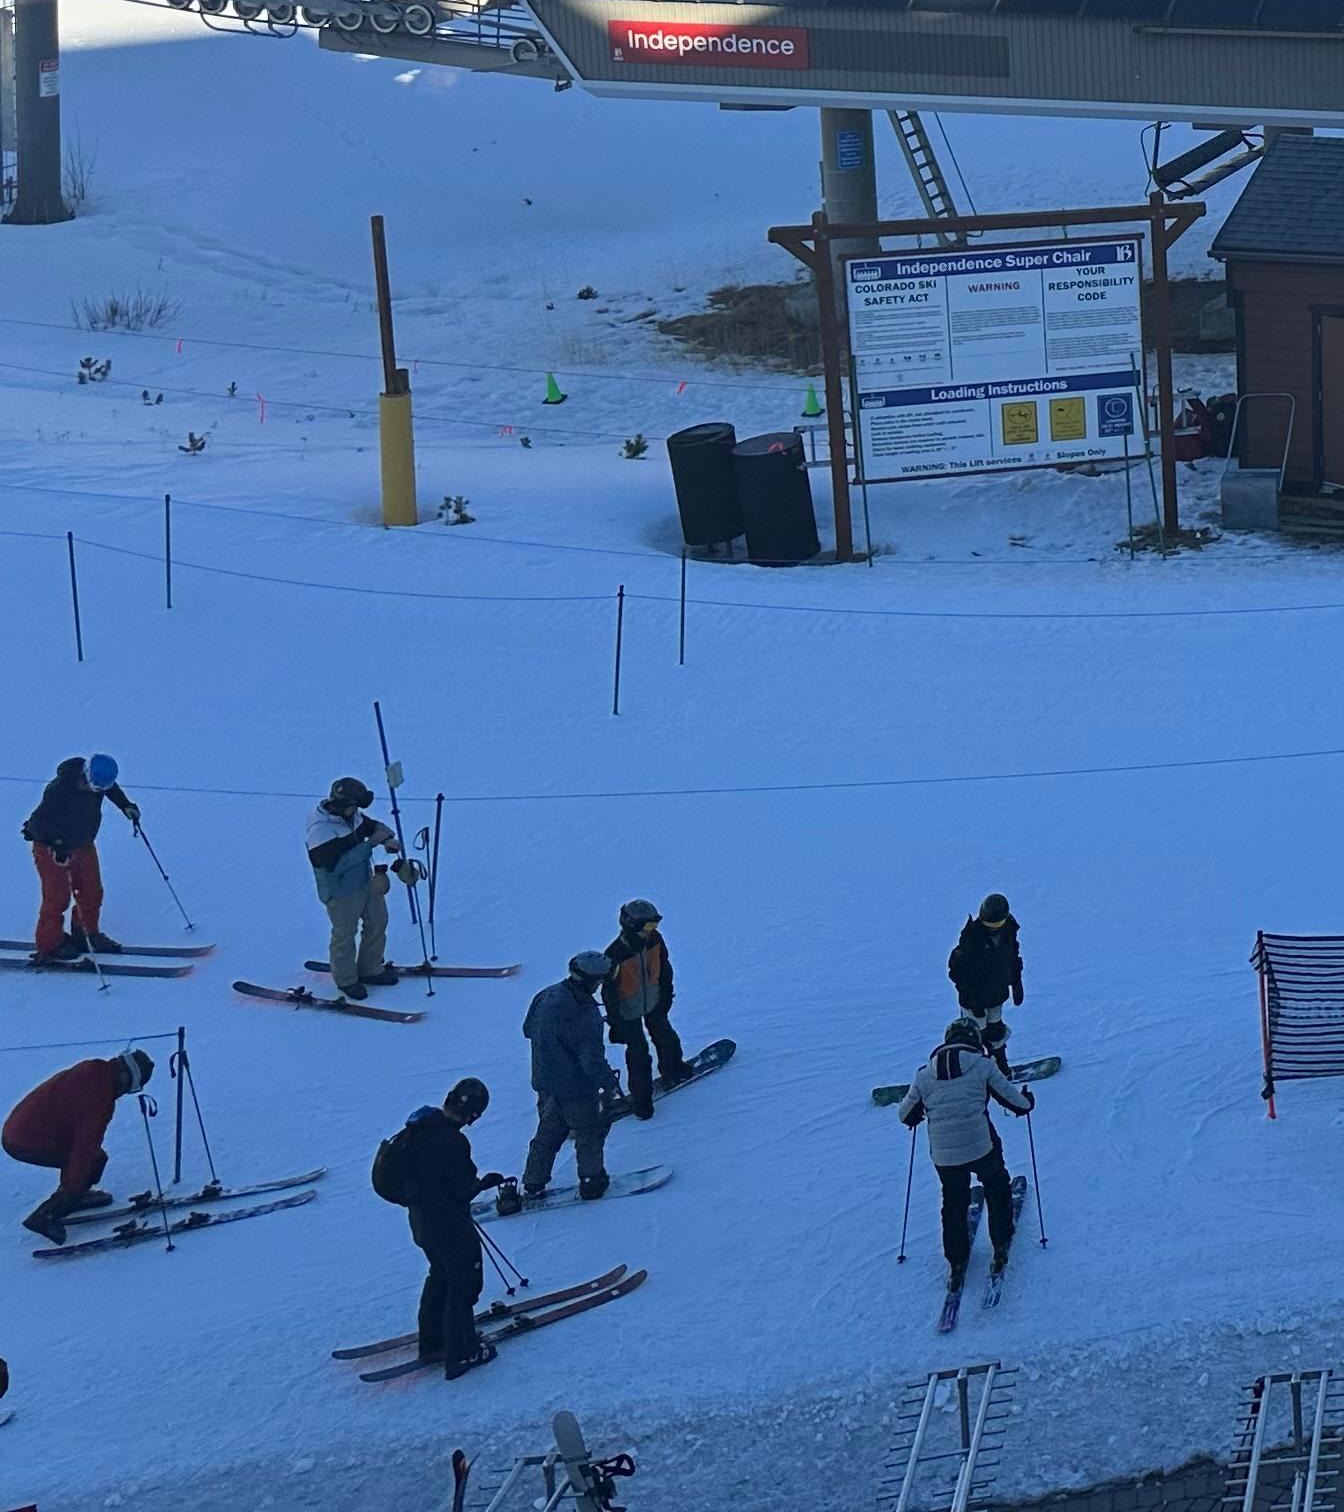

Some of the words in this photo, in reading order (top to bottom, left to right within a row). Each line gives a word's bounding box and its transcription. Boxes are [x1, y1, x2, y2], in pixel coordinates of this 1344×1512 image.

[627, 29, 795, 56] Independence
[896, 257, 1003, 276] Independence
[1005, 254, 1049, 268] Super
[1052, 249, 1092, 264] Chair
[1076, 266, 1105, 276] YOUR
[855, 281, 916, 294] COLORADO
[918, 279, 937, 290] SKI
[967, 281, 1020, 293] WARNING
[1048, 277, 1135, 291] RESPONSIBILITY
[864, 295, 906, 306] SAFETY
[909, 293, 929, 304] ACT
[1077, 291, 1107, 301] CODE
[931, 386, 985, 401] Loading
[988, 379, 1068, 396] Instructions
[949, 460, 967, 469] This
[970, 458, 984, 467] Lift
[986, 456, 1022, 466] services
[1056, 450, 1086, 459] Slopes
[1087, 448, 1107, 457] Only
